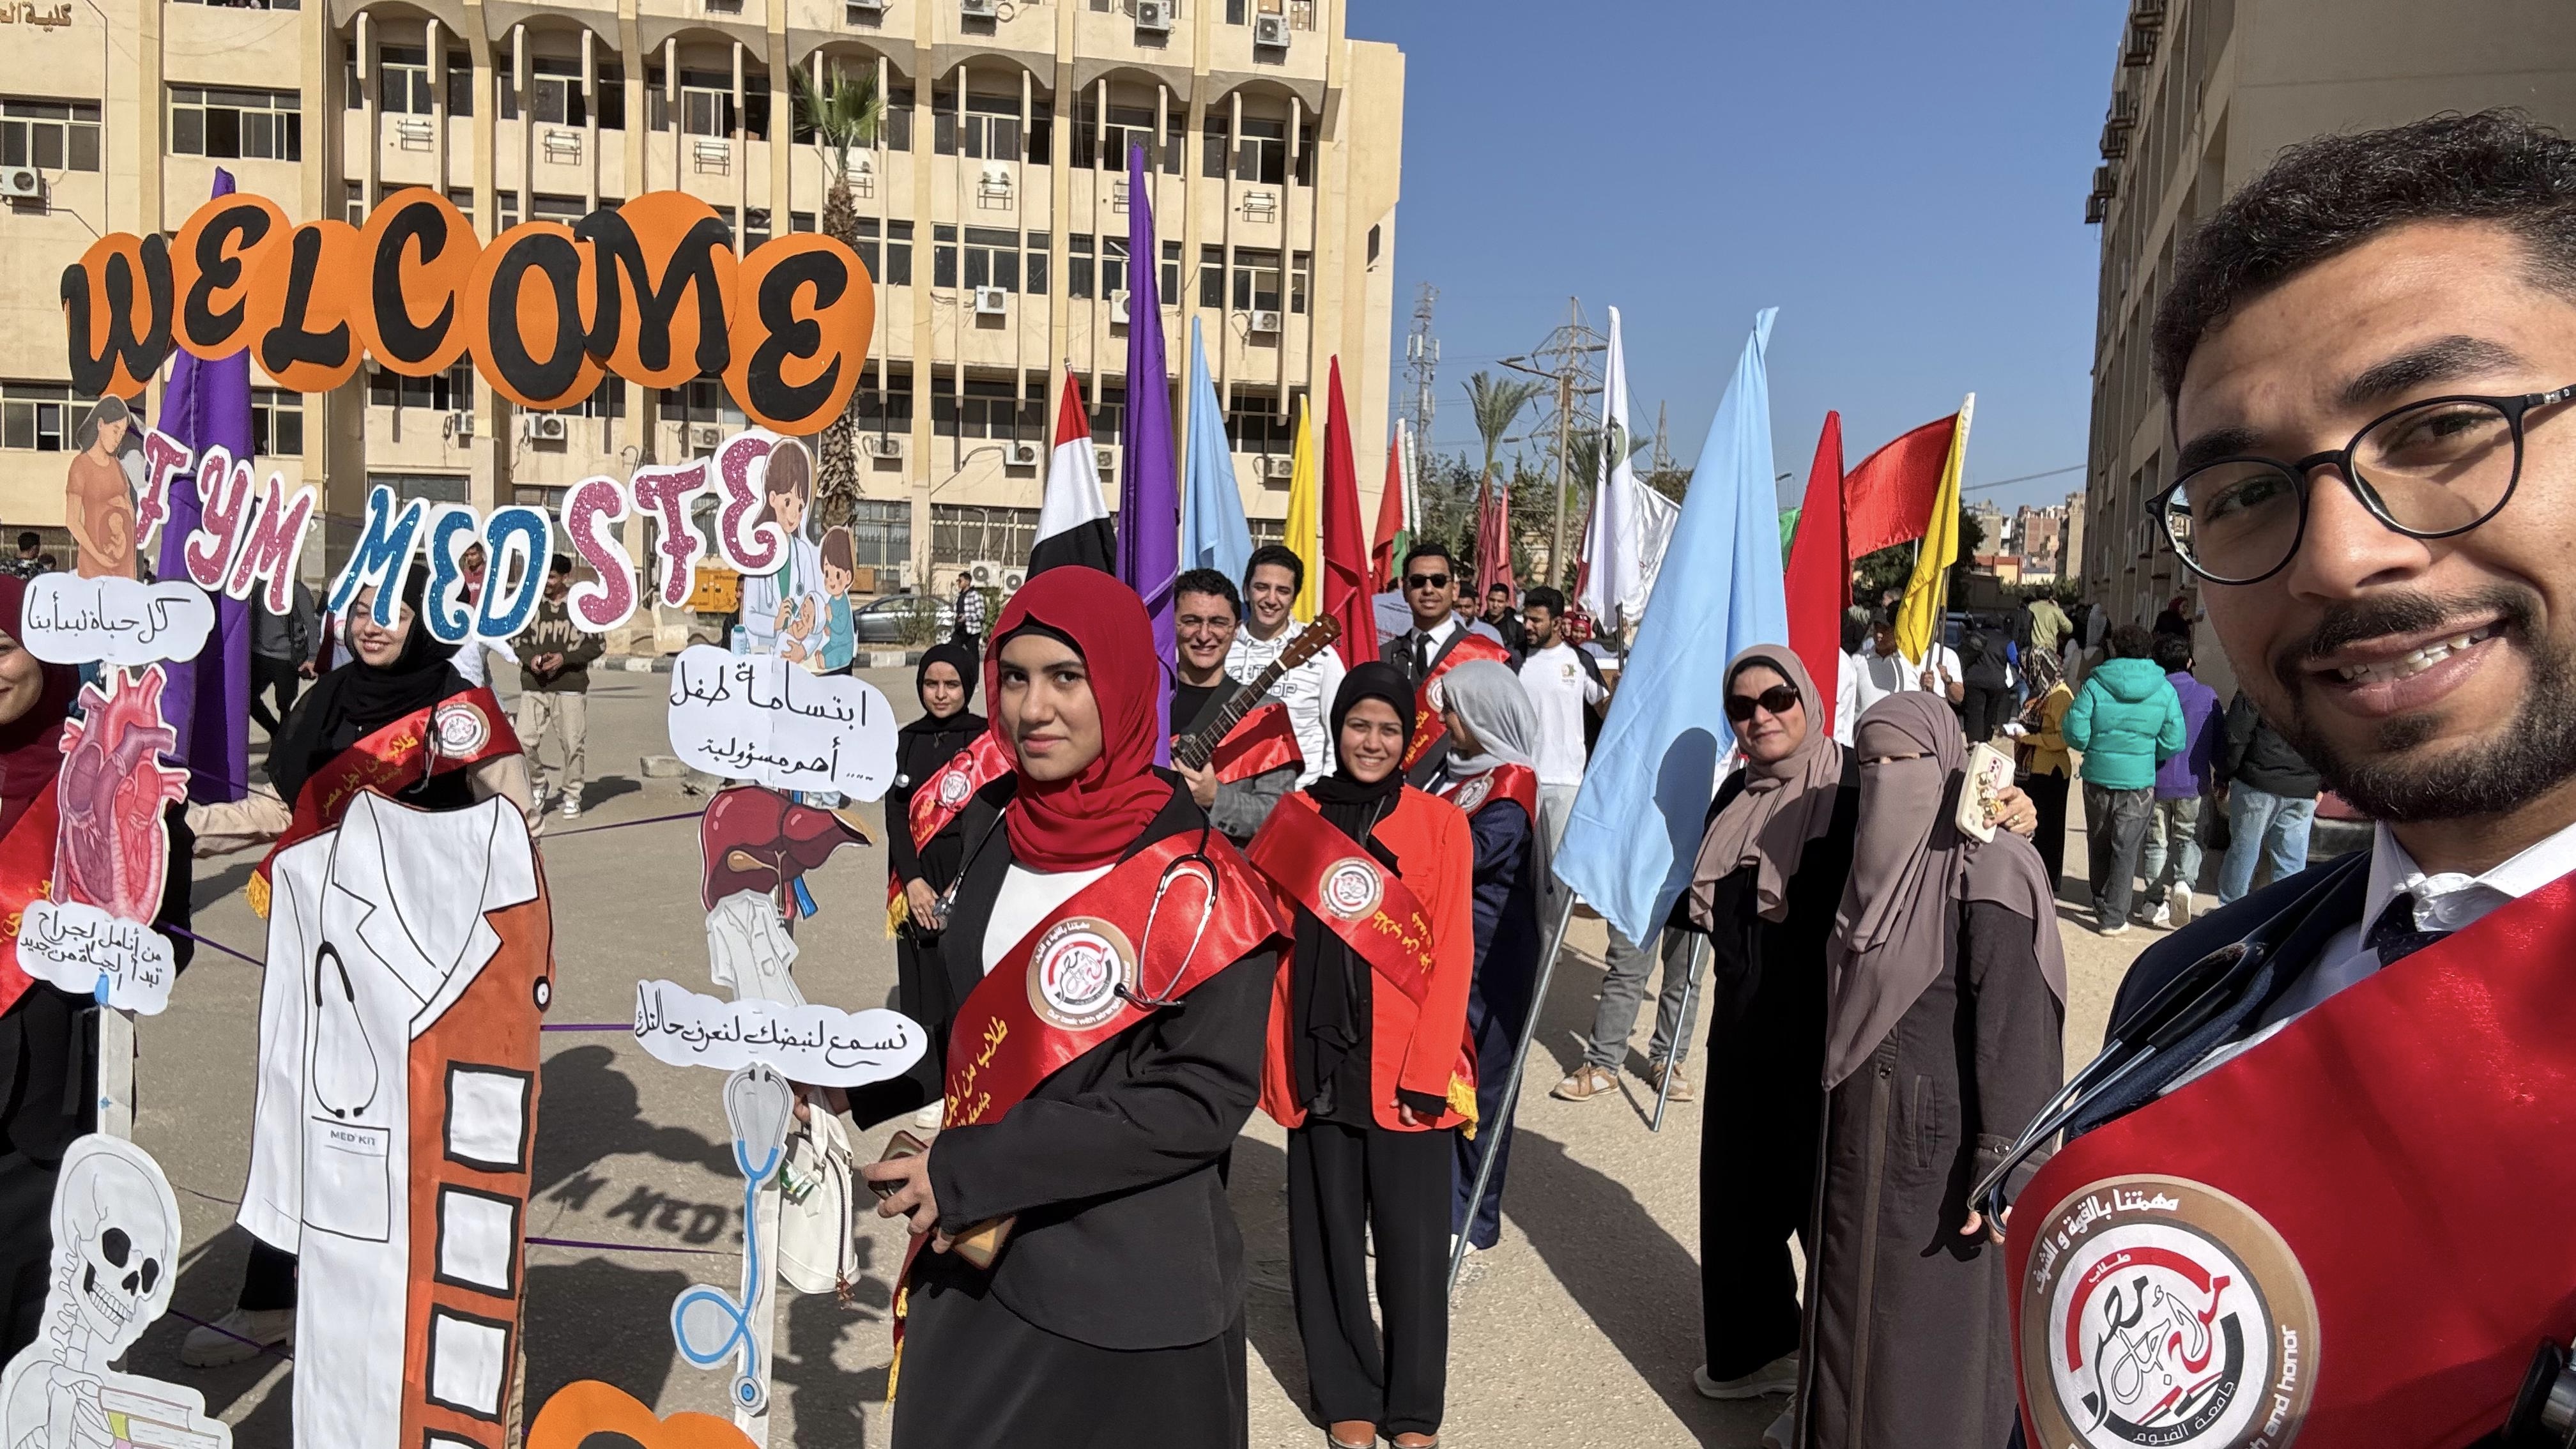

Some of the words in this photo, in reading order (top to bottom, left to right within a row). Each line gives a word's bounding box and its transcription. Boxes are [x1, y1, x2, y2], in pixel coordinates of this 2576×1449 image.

[22, 1, 72, 32] كلية
[60, 201, 849, 423] WELCOME
[327, 486, 545, 640] MED
[27, 585, 50, 633] بنا
[137, 598, 191, 644] كل
[670, 660, 731, 707] طفل
[735, 660, 866, 730] ابتسامة
[698, 737, 789, 769] مسؤولية
[781, 735, 840, 783] أهم
[20, 937, 50, 956] جديد
[47, 949, 77, 963] من
[98, 924, 139, 957] أنامل
[141, 946, 162, 963] من
[130, 953, 163, 988] تبدأ
[681, 1015, 741, 1053] لنعرف
[743, 1018, 824, 1053] لنبضك
[825, 1023, 908, 1069] نسمع
[330, 1129, 356, 1143] MED
[358, 1135, 376, 1146] KIT
[2062, 1195, 2112, 1237] بالقوة
[2112, 1188, 2179, 1211] مهمتنا
[2057, 1230, 2071, 1250] و
[2032, 1237, 2059, 1295] الشرف
[2088, 1252, 2131, 1284] طلاب
[2276, 1324, 2298, 1392] honor
[2195, 1381, 2236, 1430] جامعة
[2262, 1393, 2291, 1438] and
[2133, 1423, 2189, 1445] الفيوم
